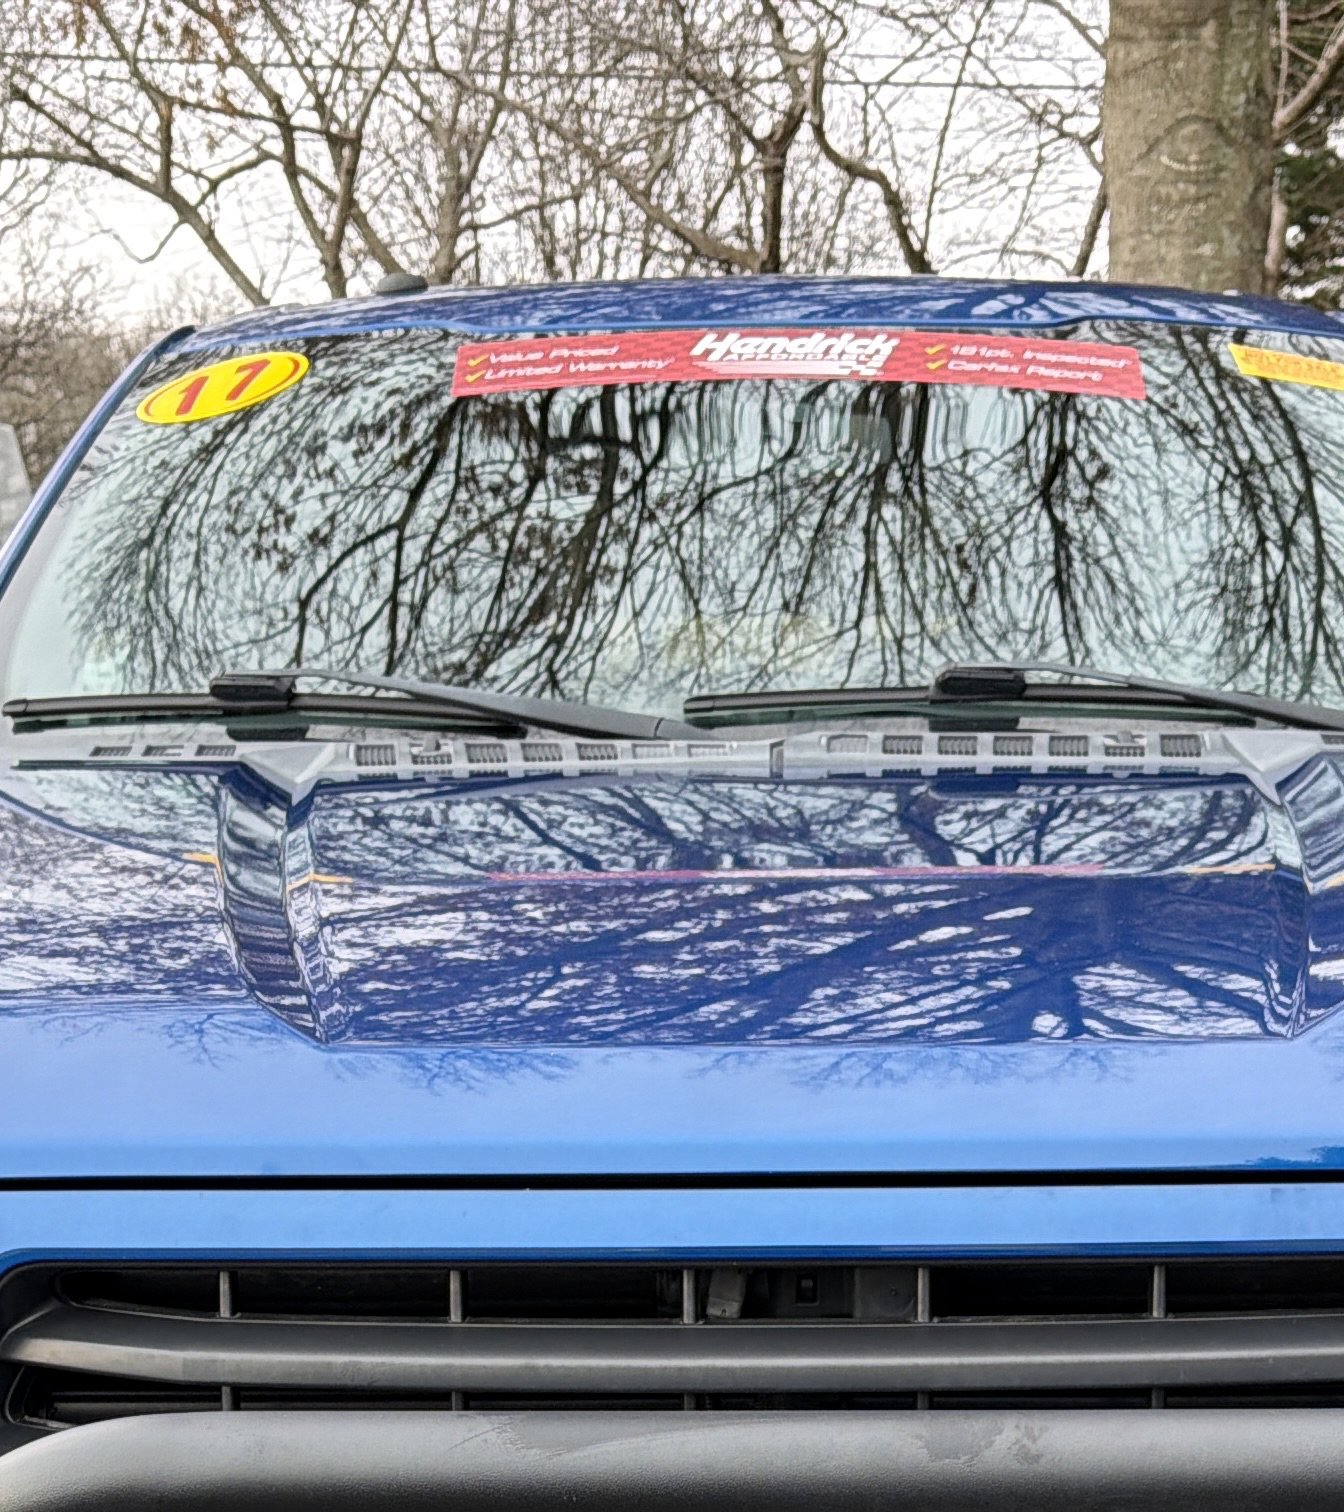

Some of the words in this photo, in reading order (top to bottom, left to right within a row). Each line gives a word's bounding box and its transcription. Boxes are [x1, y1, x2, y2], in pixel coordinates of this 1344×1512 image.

[489, 350, 546, 365] Value
[549, 345, 620, 359] Priced
[690, 332, 901, 362] Hendrick
[484, 362, 564, 381] Limited
[568, 356, 675, 373] Warranty
[1022, 349, 1128, 369] Inspected
[947, 360, 1021, 374] Carfax
[1025, 364, 1104, 382] Report
[175, 359, 271, 417] 17
